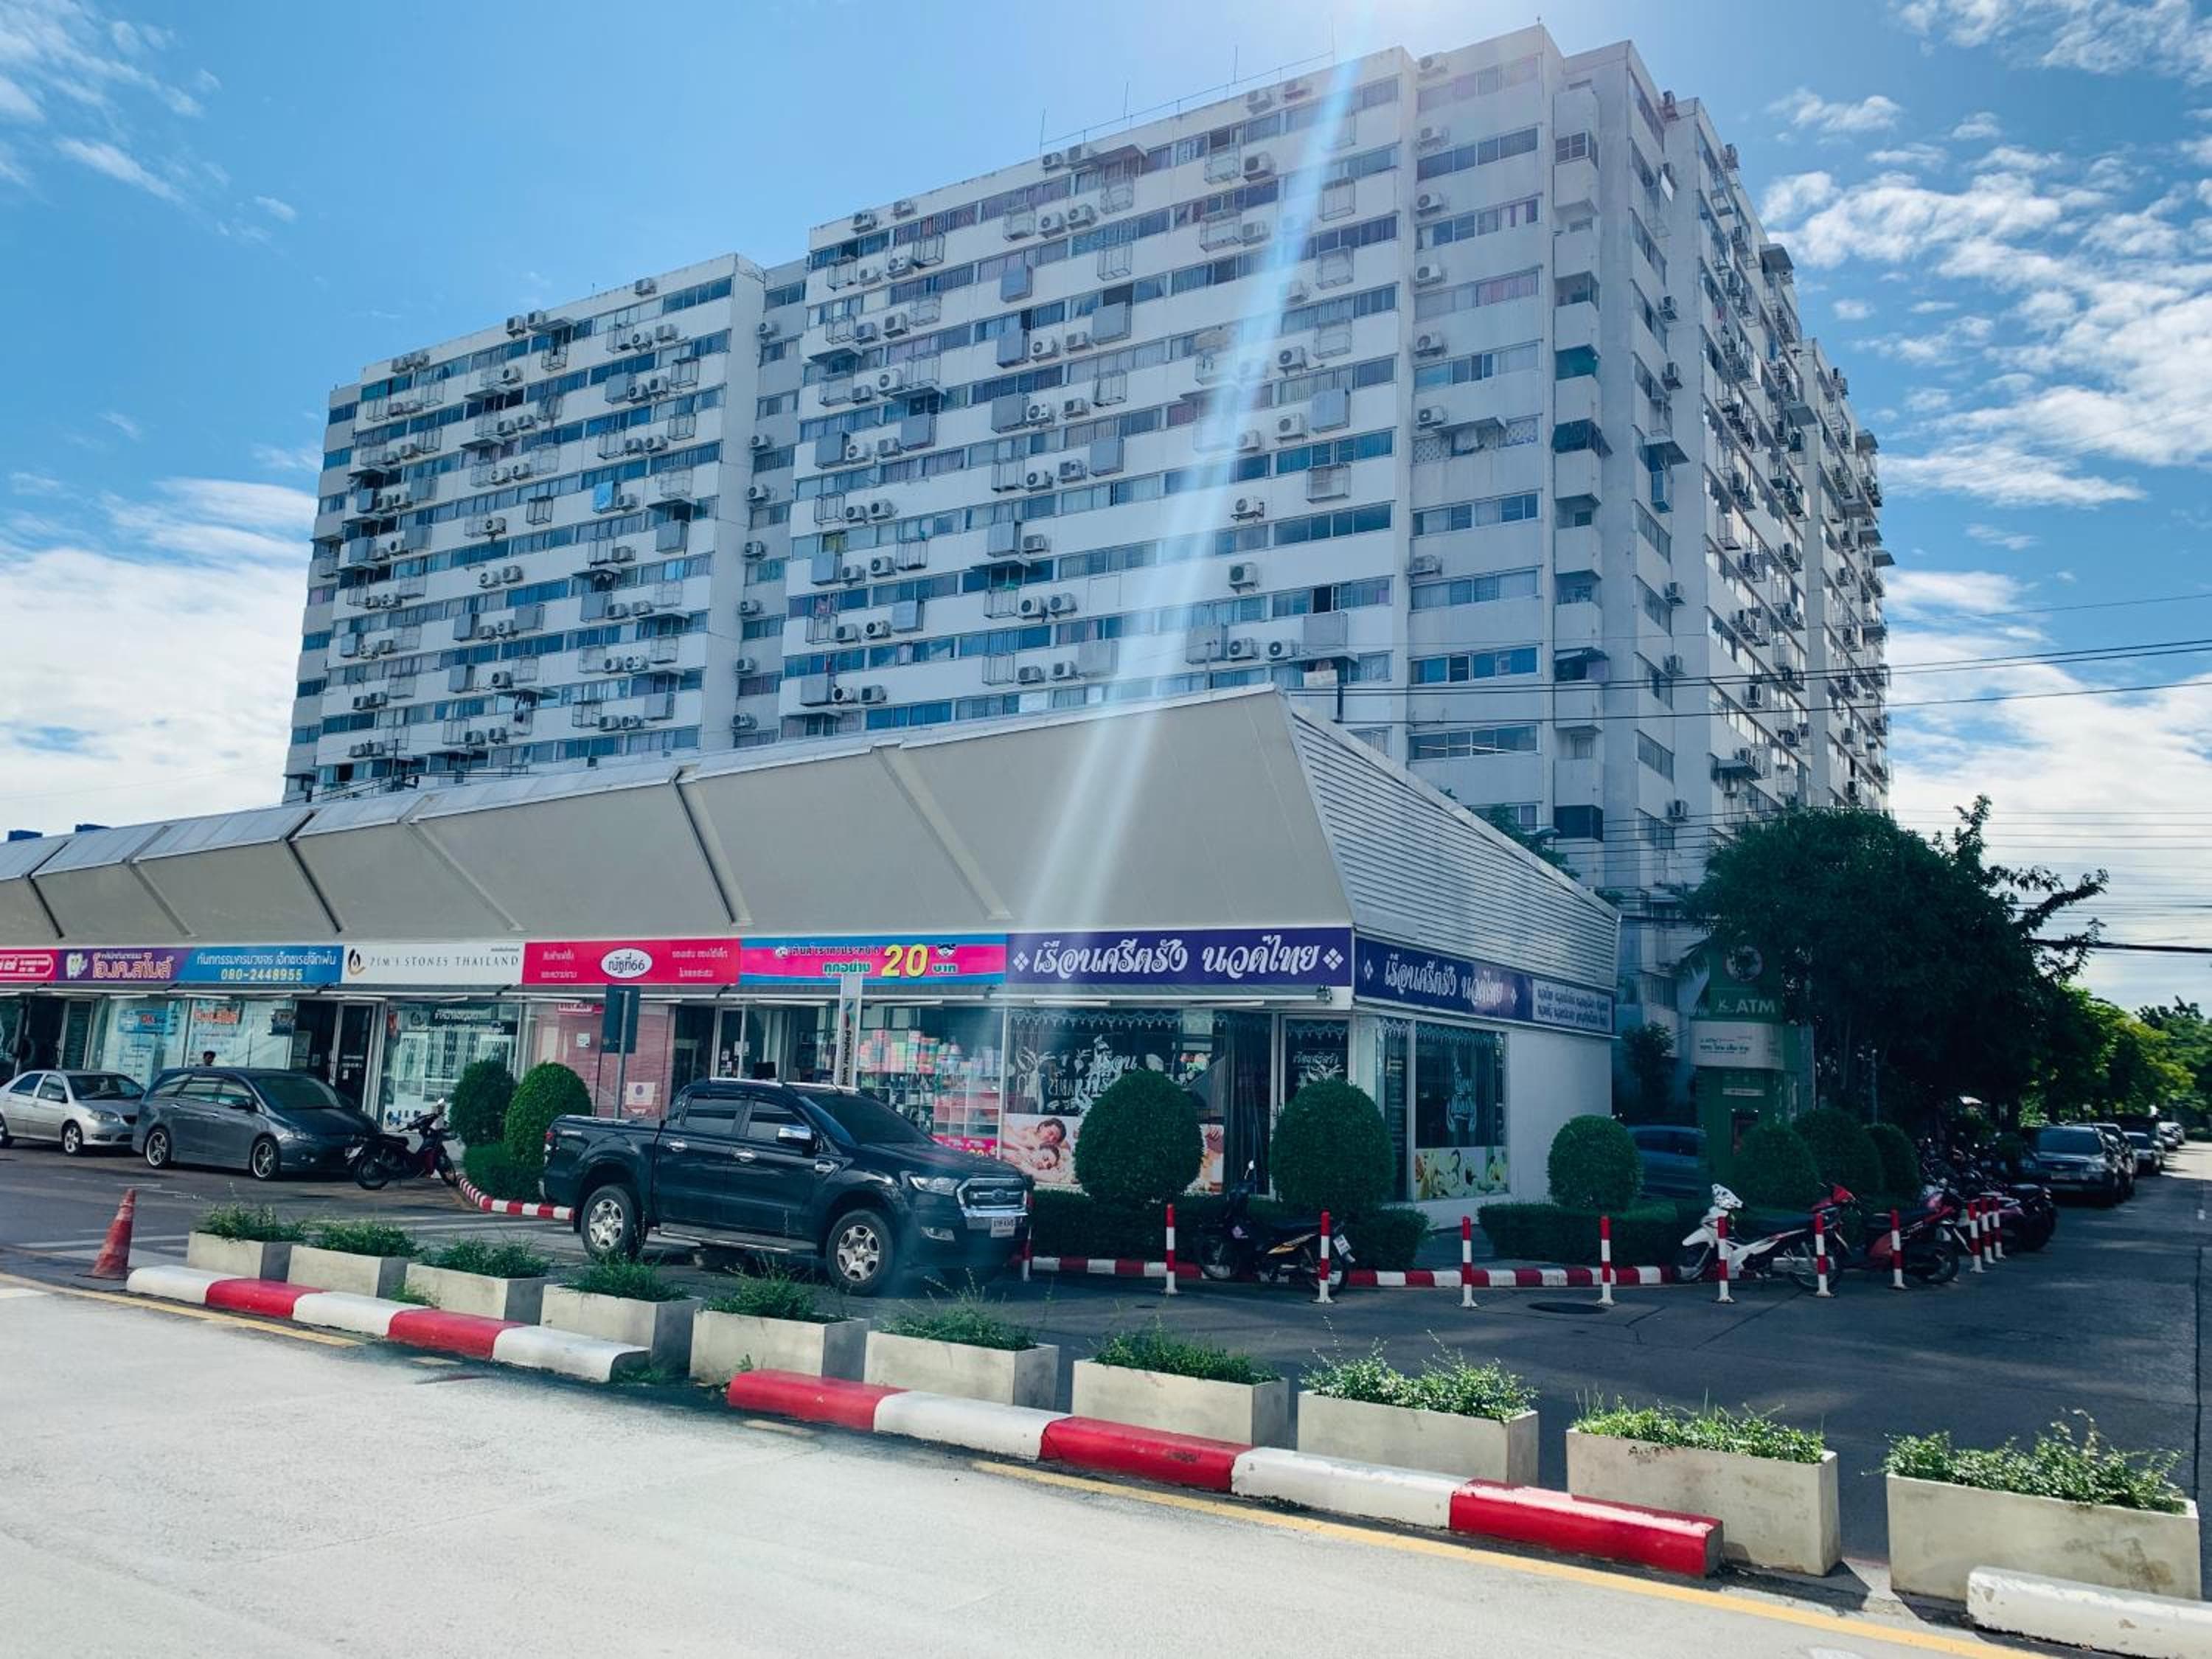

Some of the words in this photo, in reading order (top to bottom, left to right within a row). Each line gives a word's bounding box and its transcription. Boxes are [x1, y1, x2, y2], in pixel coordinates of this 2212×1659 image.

[404, 956, 449, 967] STONES
[455, 955, 519, 967] THAILAND
[881, 943, 930, 977] 20
[1033, 939, 1188, 979] เรือนศรีตรัง
[1202, 934, 1321, 979] นวดไทย
[1736, 998, 1776, 1014] ATM
